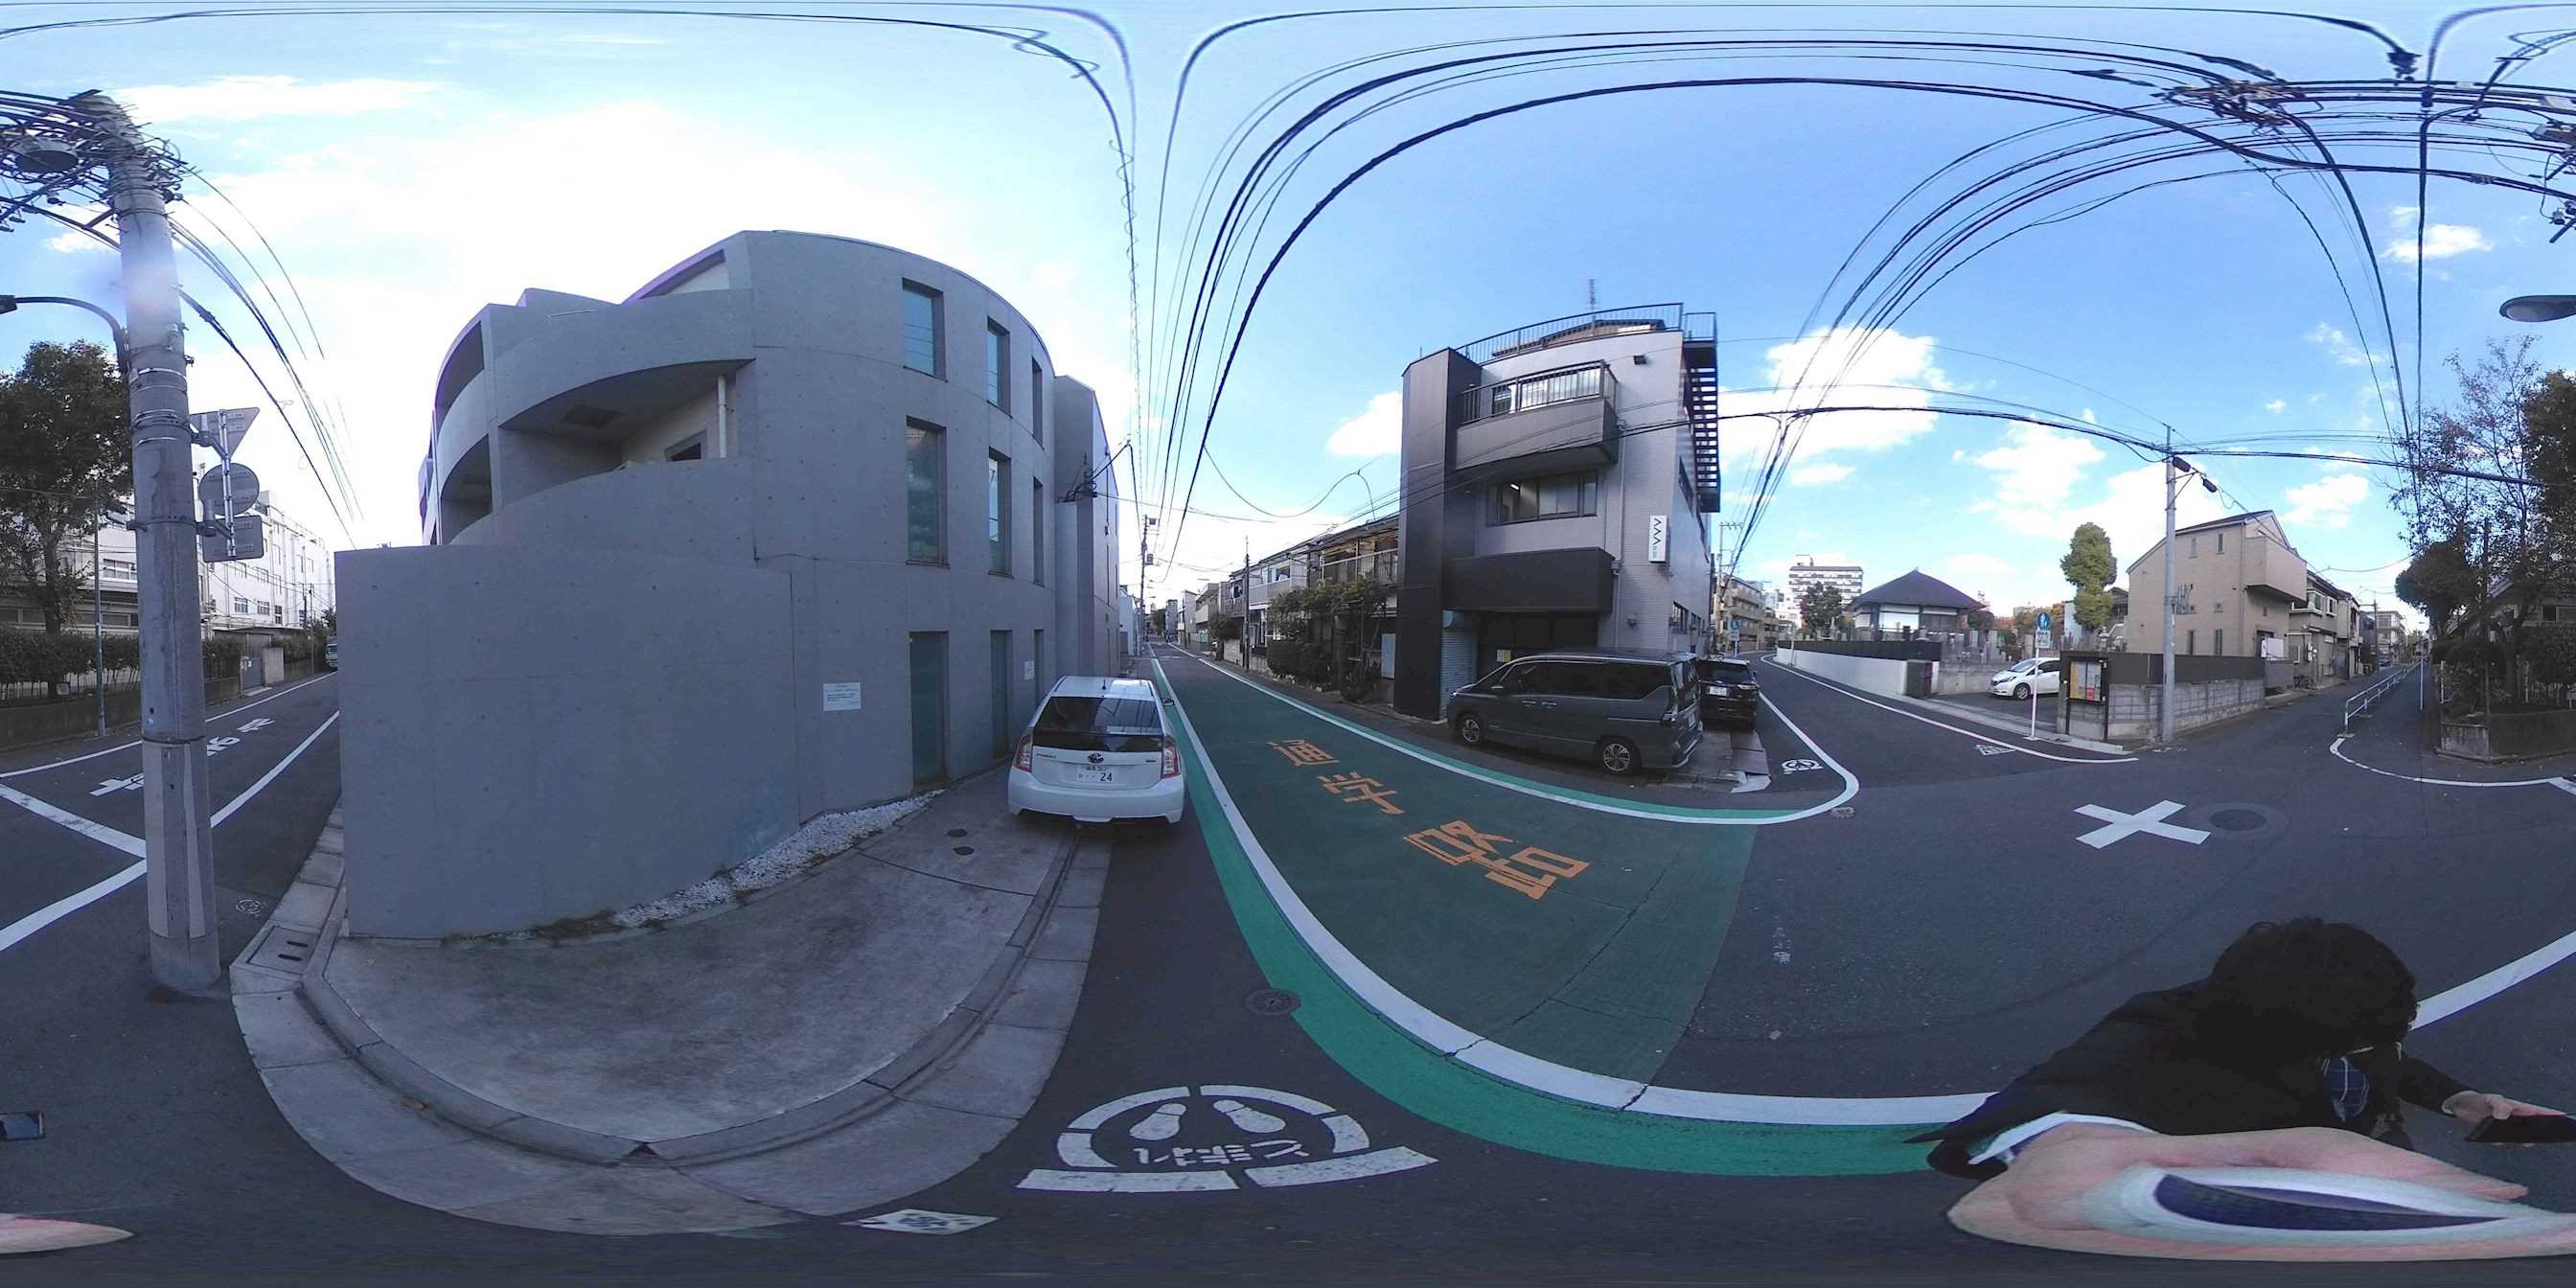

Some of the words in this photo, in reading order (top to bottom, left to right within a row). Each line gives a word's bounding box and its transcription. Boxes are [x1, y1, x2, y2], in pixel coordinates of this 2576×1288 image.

[1267, 739, 1591, 901] 通学路
[1132, 1139, 1309, 1166] とまれ
